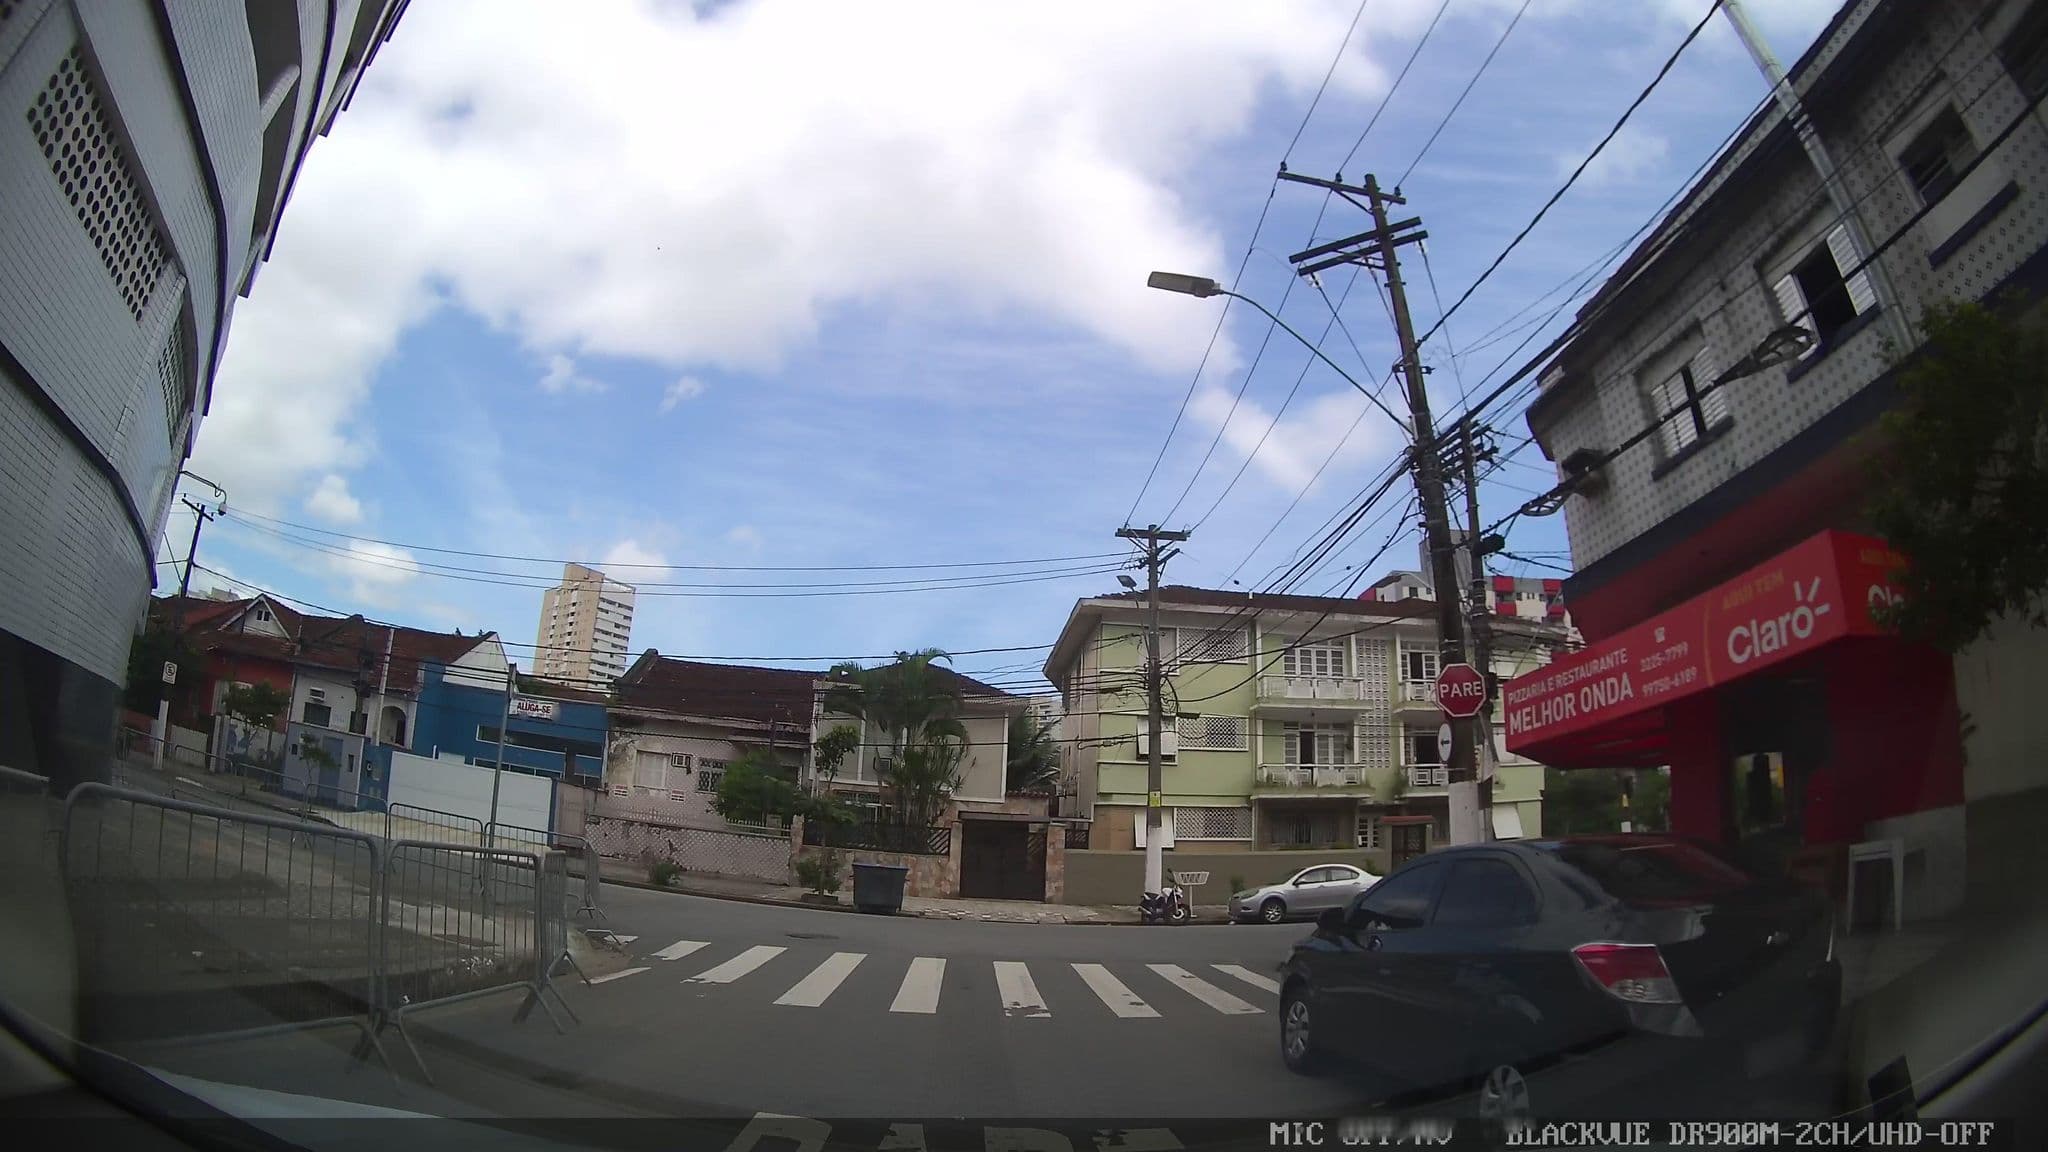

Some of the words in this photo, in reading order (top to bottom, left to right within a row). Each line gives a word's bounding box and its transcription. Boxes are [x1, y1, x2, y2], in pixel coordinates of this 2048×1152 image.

[1728, 605, 1814, 663] Claro
[1440, 681, 1483, 698] PARE
[1508, 679, 1547, 705] PIZZARIA
[1547, 678, 1555, 691] E
[1554, 648, 1628, 686] RESTAURANTE
[1509, 694, 1577, 736] MELHOR
[1580, 672, 1634, 713] ONDA
[517, 702, 551, 713] ALUGA-SE
